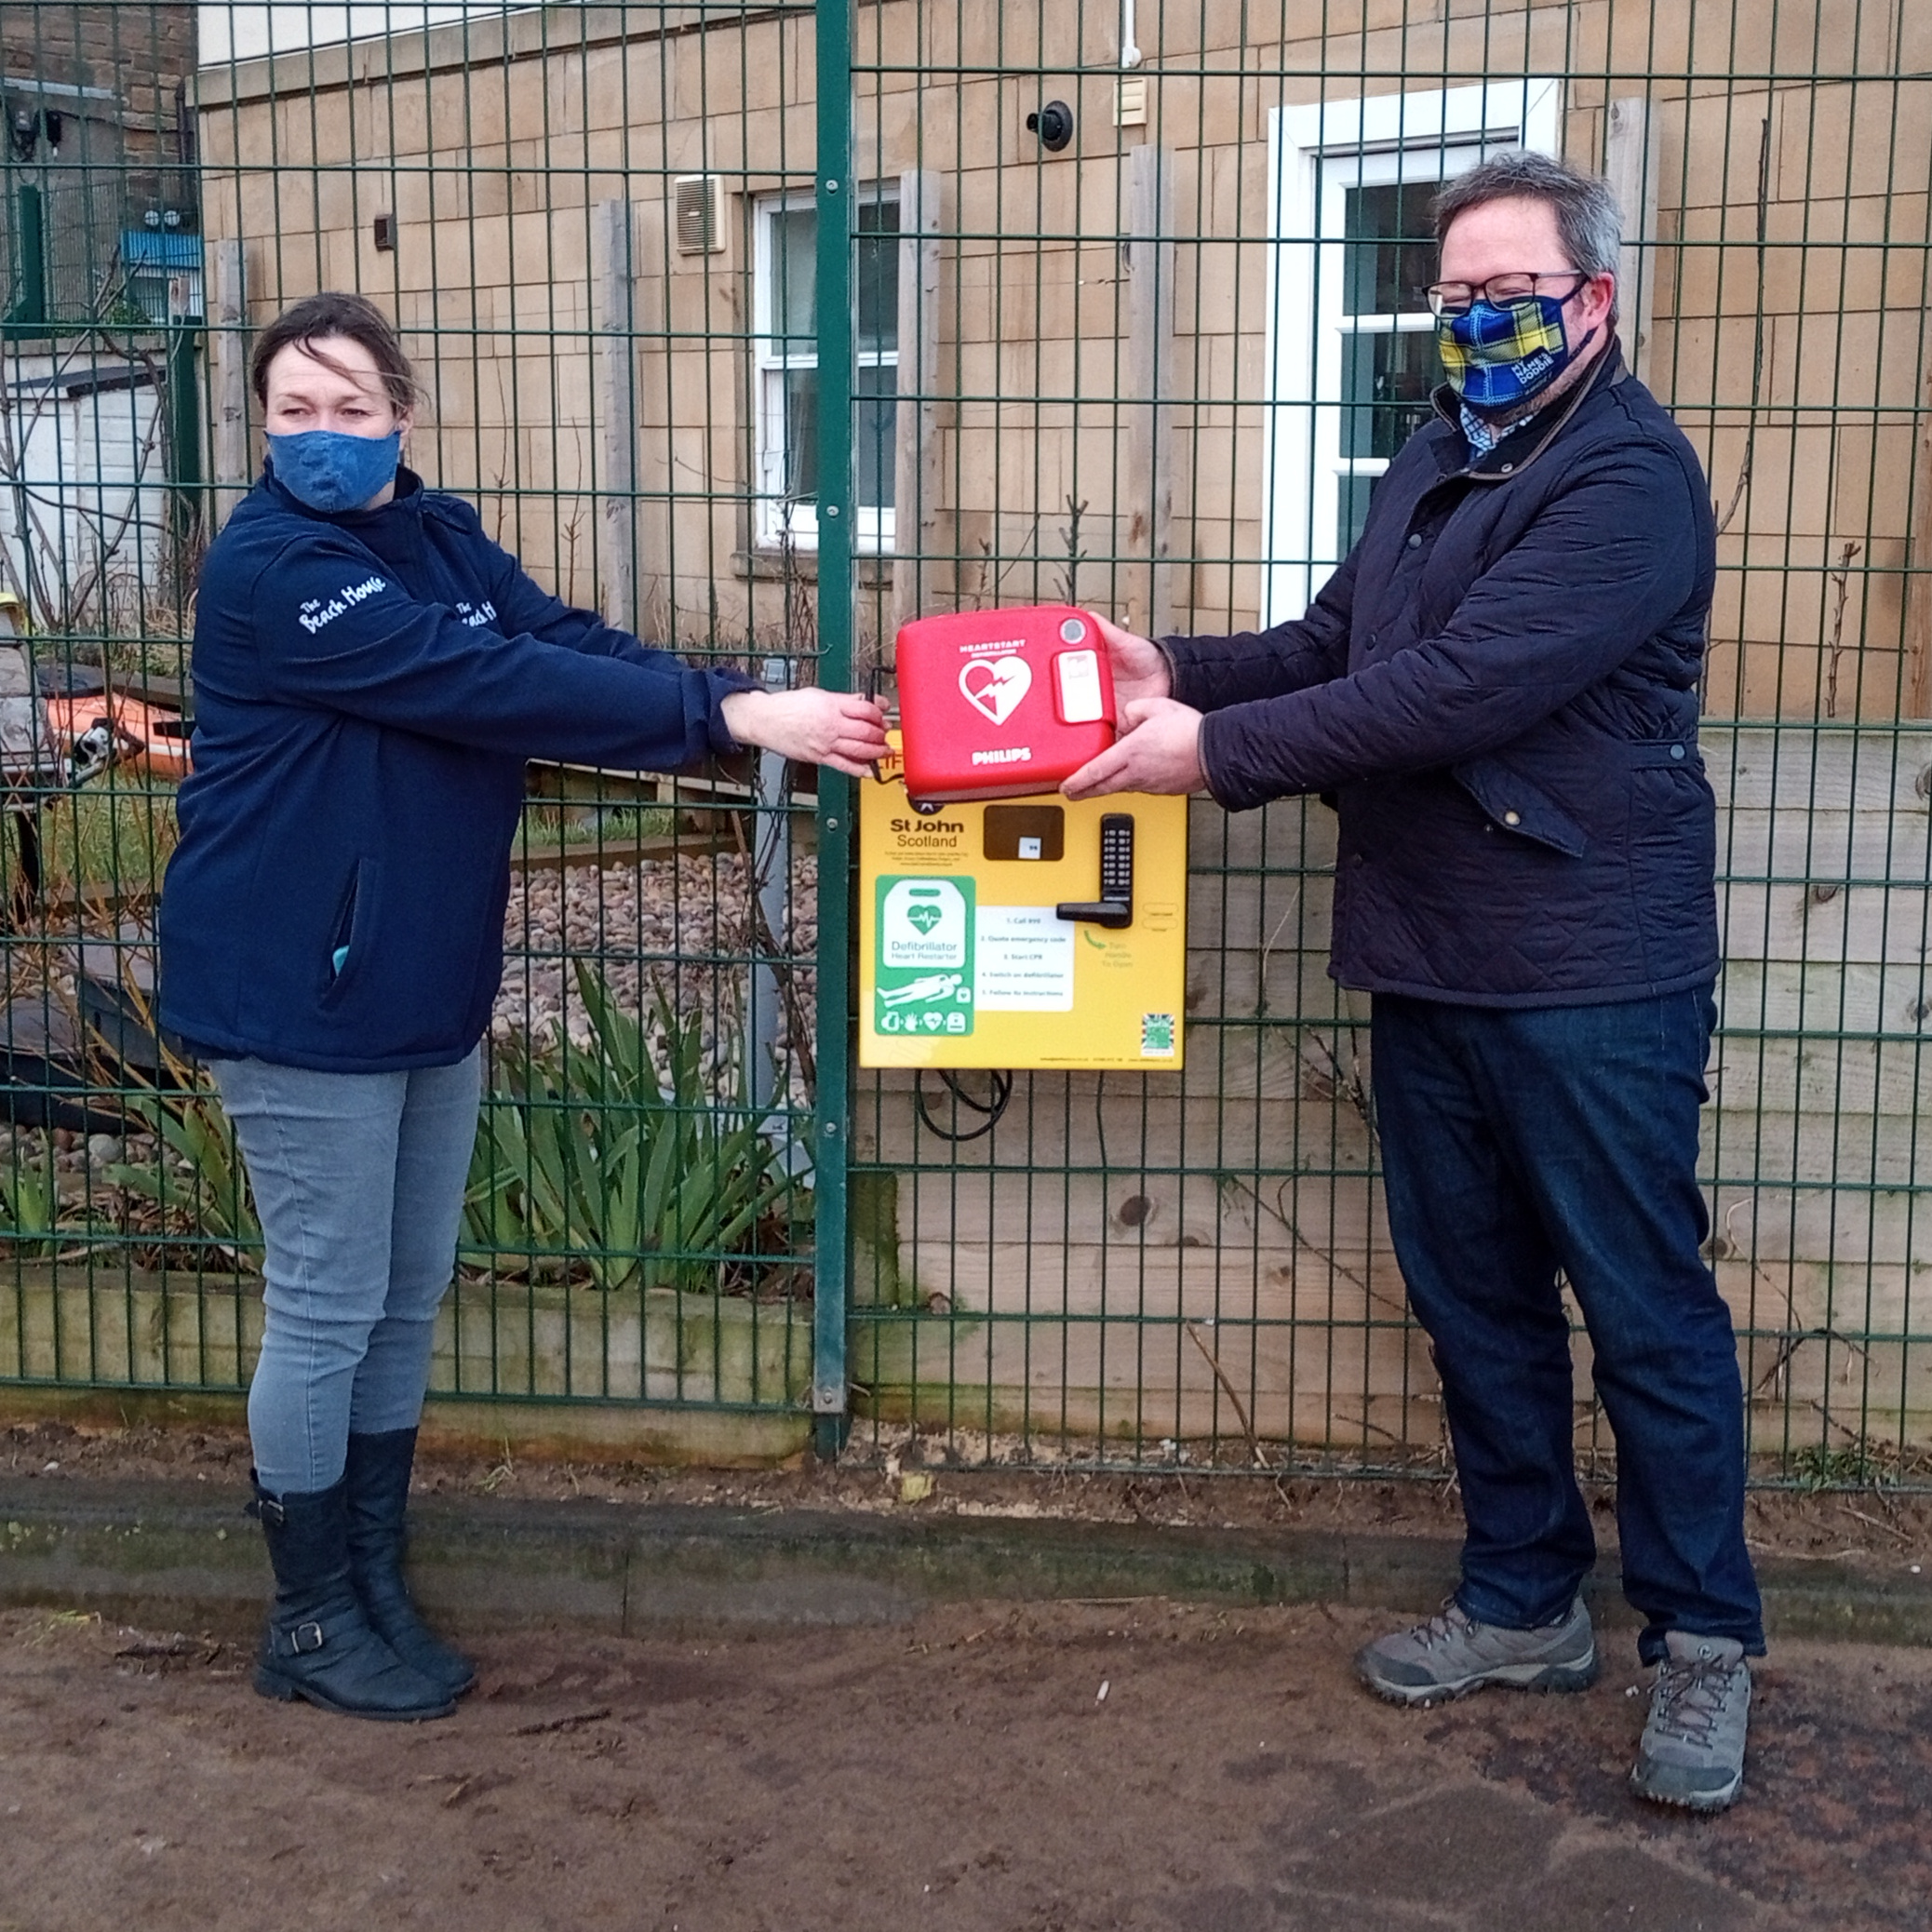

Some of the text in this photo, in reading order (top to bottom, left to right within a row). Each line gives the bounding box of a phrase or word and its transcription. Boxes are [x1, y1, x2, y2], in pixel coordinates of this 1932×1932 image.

[1511, 359, 1524, 372] MY
[1516, 353, 1549, 378] NAME'S
[1519, 356, 1554, 384] DODDIE
[299, 576, 386, 634] Beach House
[300, 598, 320, 613] The
[959, 639, 1026, 653] HEARTSTART
[972, 747, 1032, 765] PHILIPS
[890, 819, 964, 833] St John
[897, 834, 958, 848] Scotland
[892, 941, 957, 951] Defibrillator
